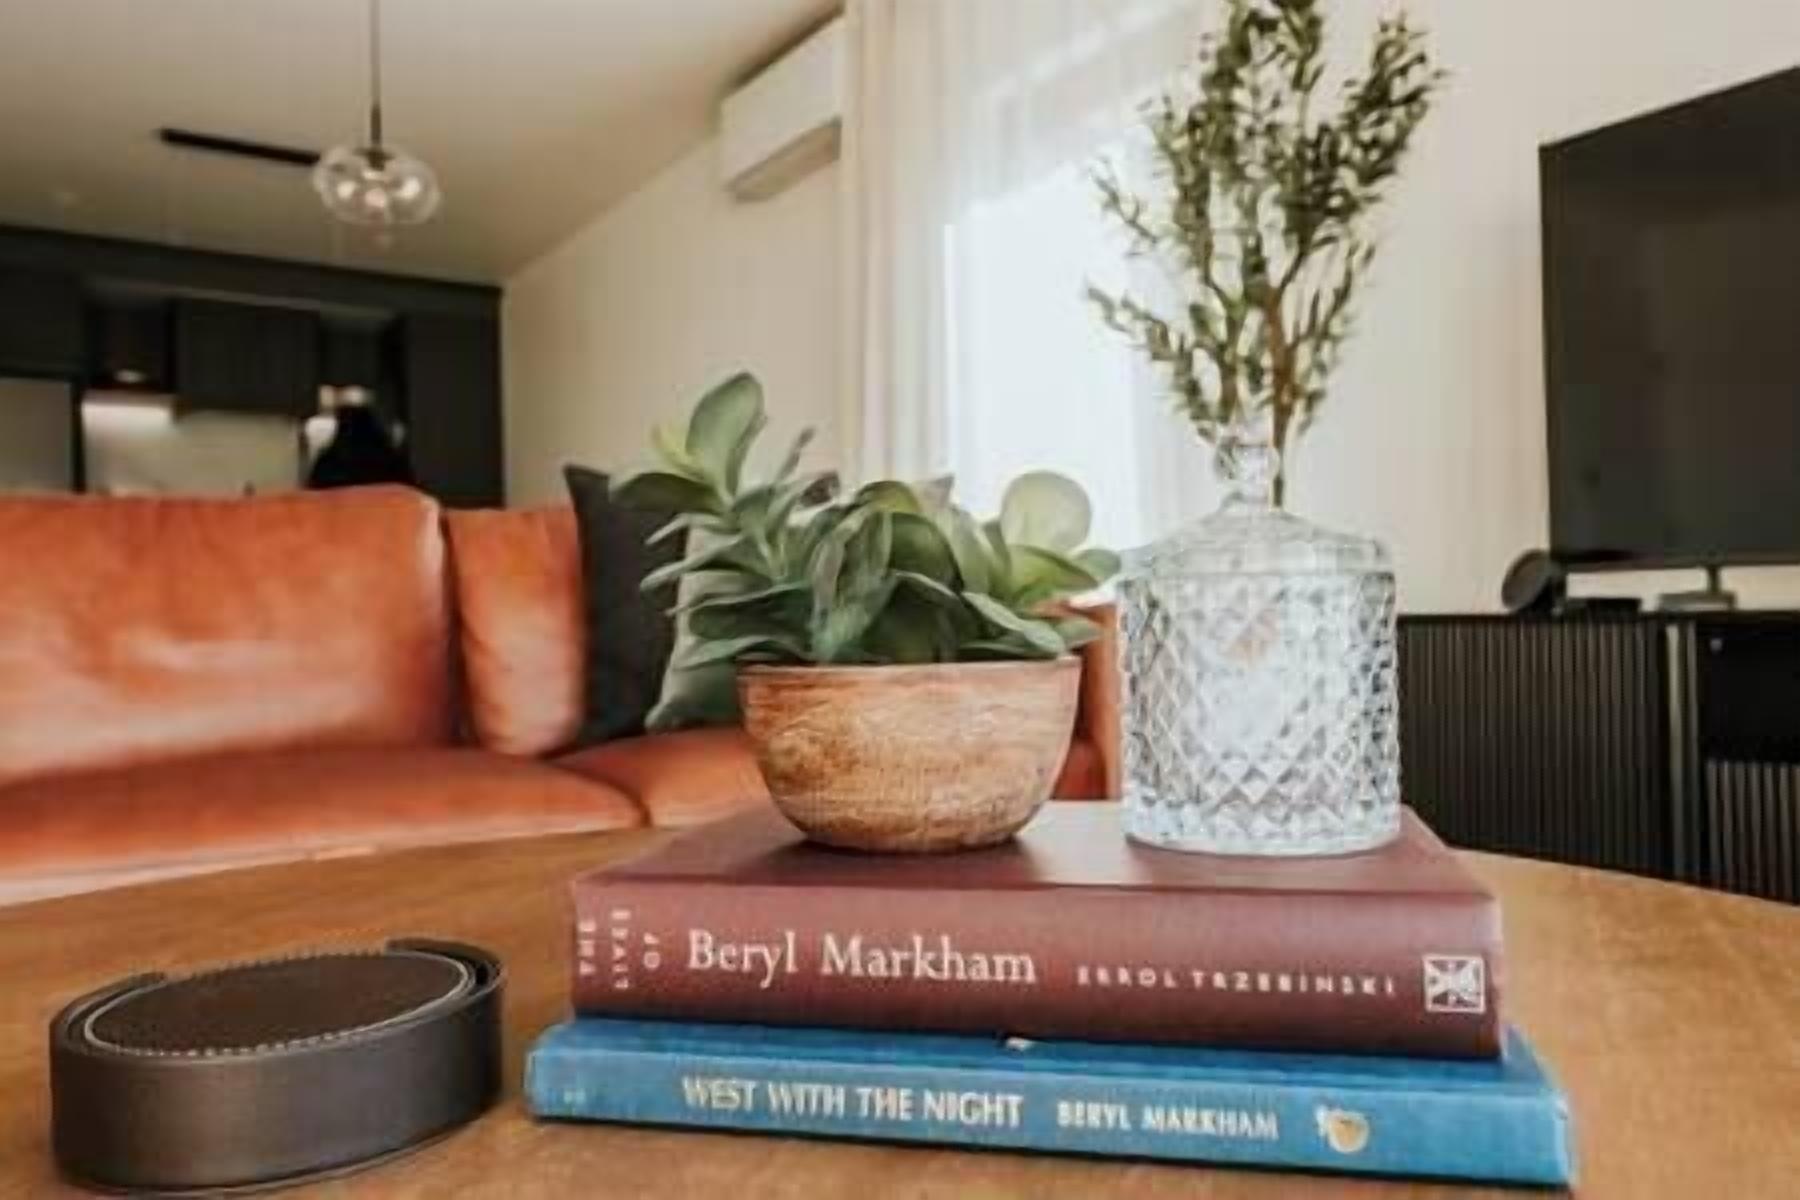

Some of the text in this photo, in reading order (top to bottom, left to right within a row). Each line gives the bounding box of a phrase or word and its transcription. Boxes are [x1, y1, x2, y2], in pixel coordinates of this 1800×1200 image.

[687, 928, 1037, 989] Beryl Markham
[681, 1075, 1025, 1128] WEST WITH THE NIGHT
[1056, 1100, 1280, 1140] BERYL MARKHAM
